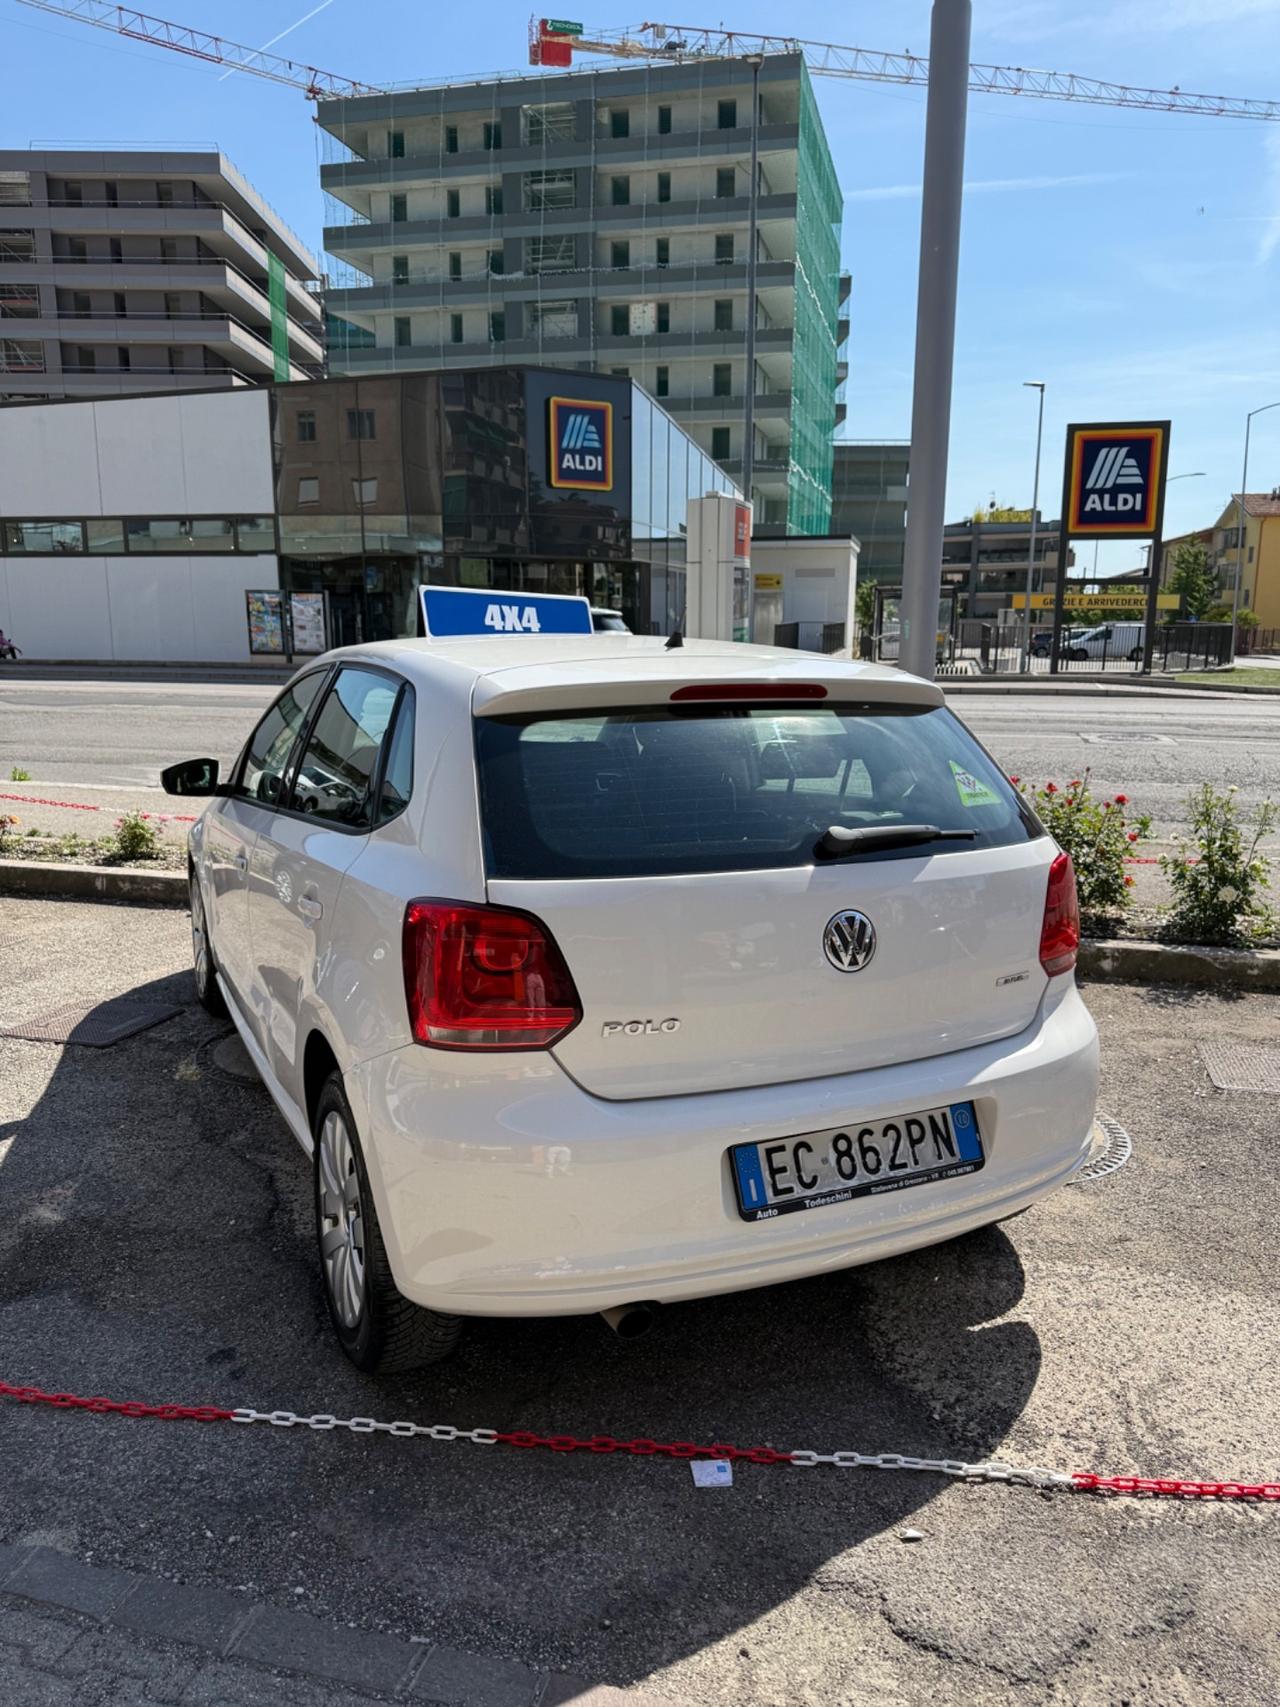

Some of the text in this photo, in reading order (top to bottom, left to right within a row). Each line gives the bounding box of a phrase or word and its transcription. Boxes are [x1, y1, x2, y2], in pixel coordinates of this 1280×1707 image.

[562, 453, 603, 472] ALDI
[1084, 493, 1142, 511] ALDI
[1042, 597, 1076, 606] GRZIE
[1078, 597, 1084, 606] E
[484, 604, 541, 632] 4X4
[601, 1017, 681, 1038] POLO
[764, 1112, 957, 1198] EC 862PN
[756, 1190, 852, 1219] Auto Todeschini
